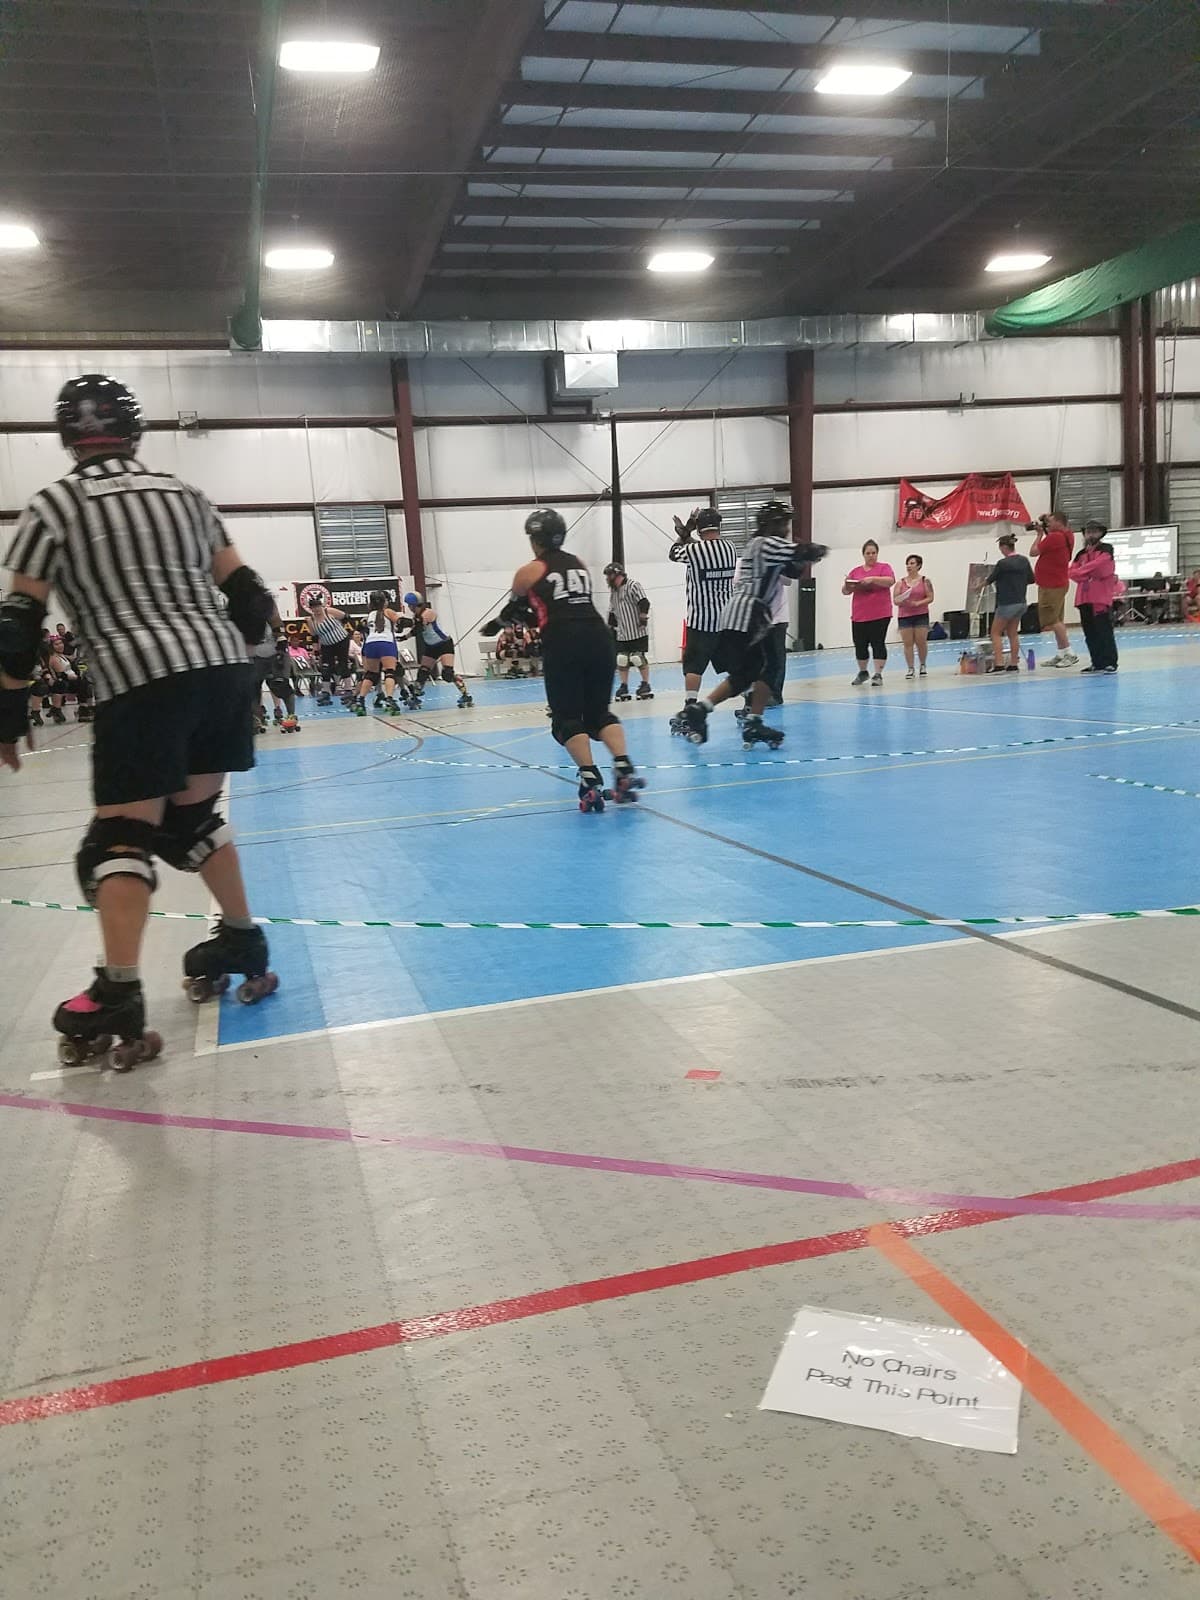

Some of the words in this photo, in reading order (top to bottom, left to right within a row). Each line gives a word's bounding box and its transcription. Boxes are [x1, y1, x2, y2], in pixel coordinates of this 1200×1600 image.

[332, 597, 367, 606] ROLLER
[842, 1351, 875, 1368] No
[882, 1358, 957, 1381] Chairs
[805, 1368, 852, 1389] Past
[864, 1379, 911, 1398] This
[916, 1387, 979, 1410] Point
